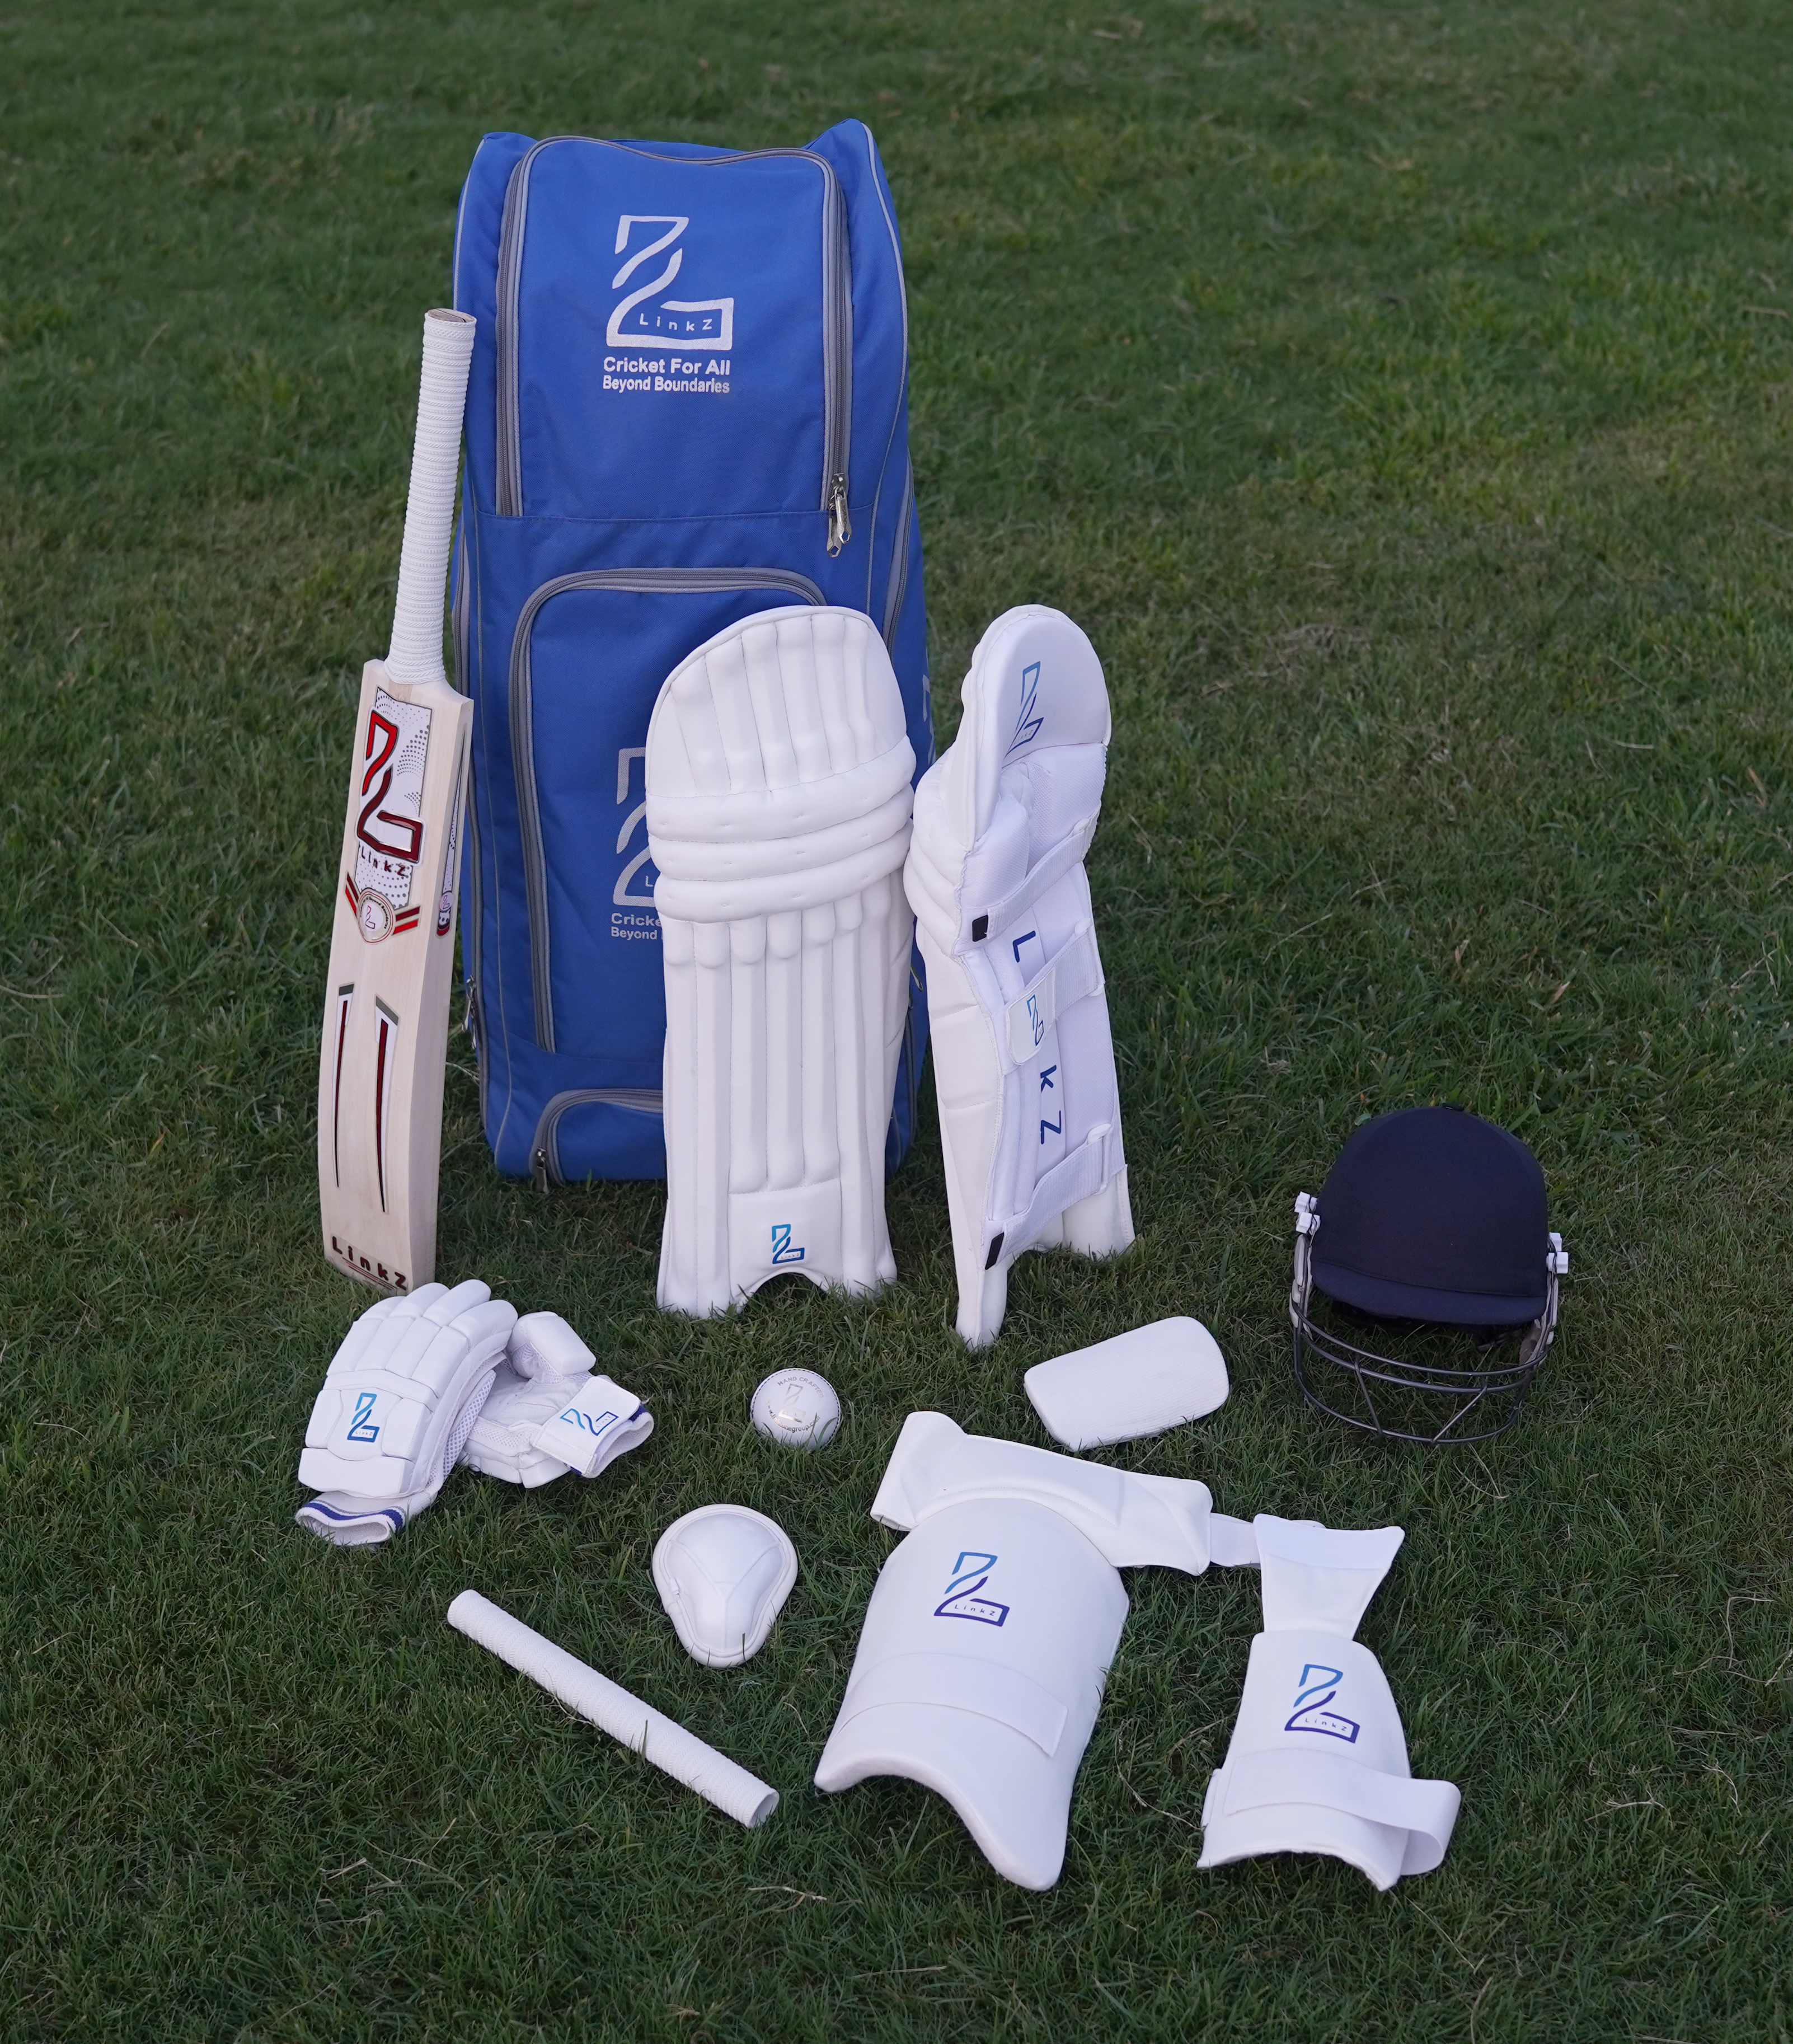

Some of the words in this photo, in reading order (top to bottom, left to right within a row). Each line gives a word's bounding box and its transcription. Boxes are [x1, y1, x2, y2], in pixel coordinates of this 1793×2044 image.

[639, 313, 712, 331] LinkZ
[603, 356, 665, 373] Cricket
[670, 358, 702, 374] For
[705, 359, 730, 376] All
[603, 374, 651, 393] Beyond
[654, 376, 730, 393] Boundaries
[361, 846, 406, 876] LinkZ
[611, 912, 661, 927] Cricke
[611, 926, 658, 941] Beyond
[1012, 930, 1062, 1145] LkZ
[332, 1236, 406, 1291] LinkZ
[777, 1376, 797, 1386] HAND
[799, 1377, 824, 1398] CRAFTED
[954, 1604, 996, 1616] LinkZ
[1305, 1717, 1348, 1732] LinkZ
